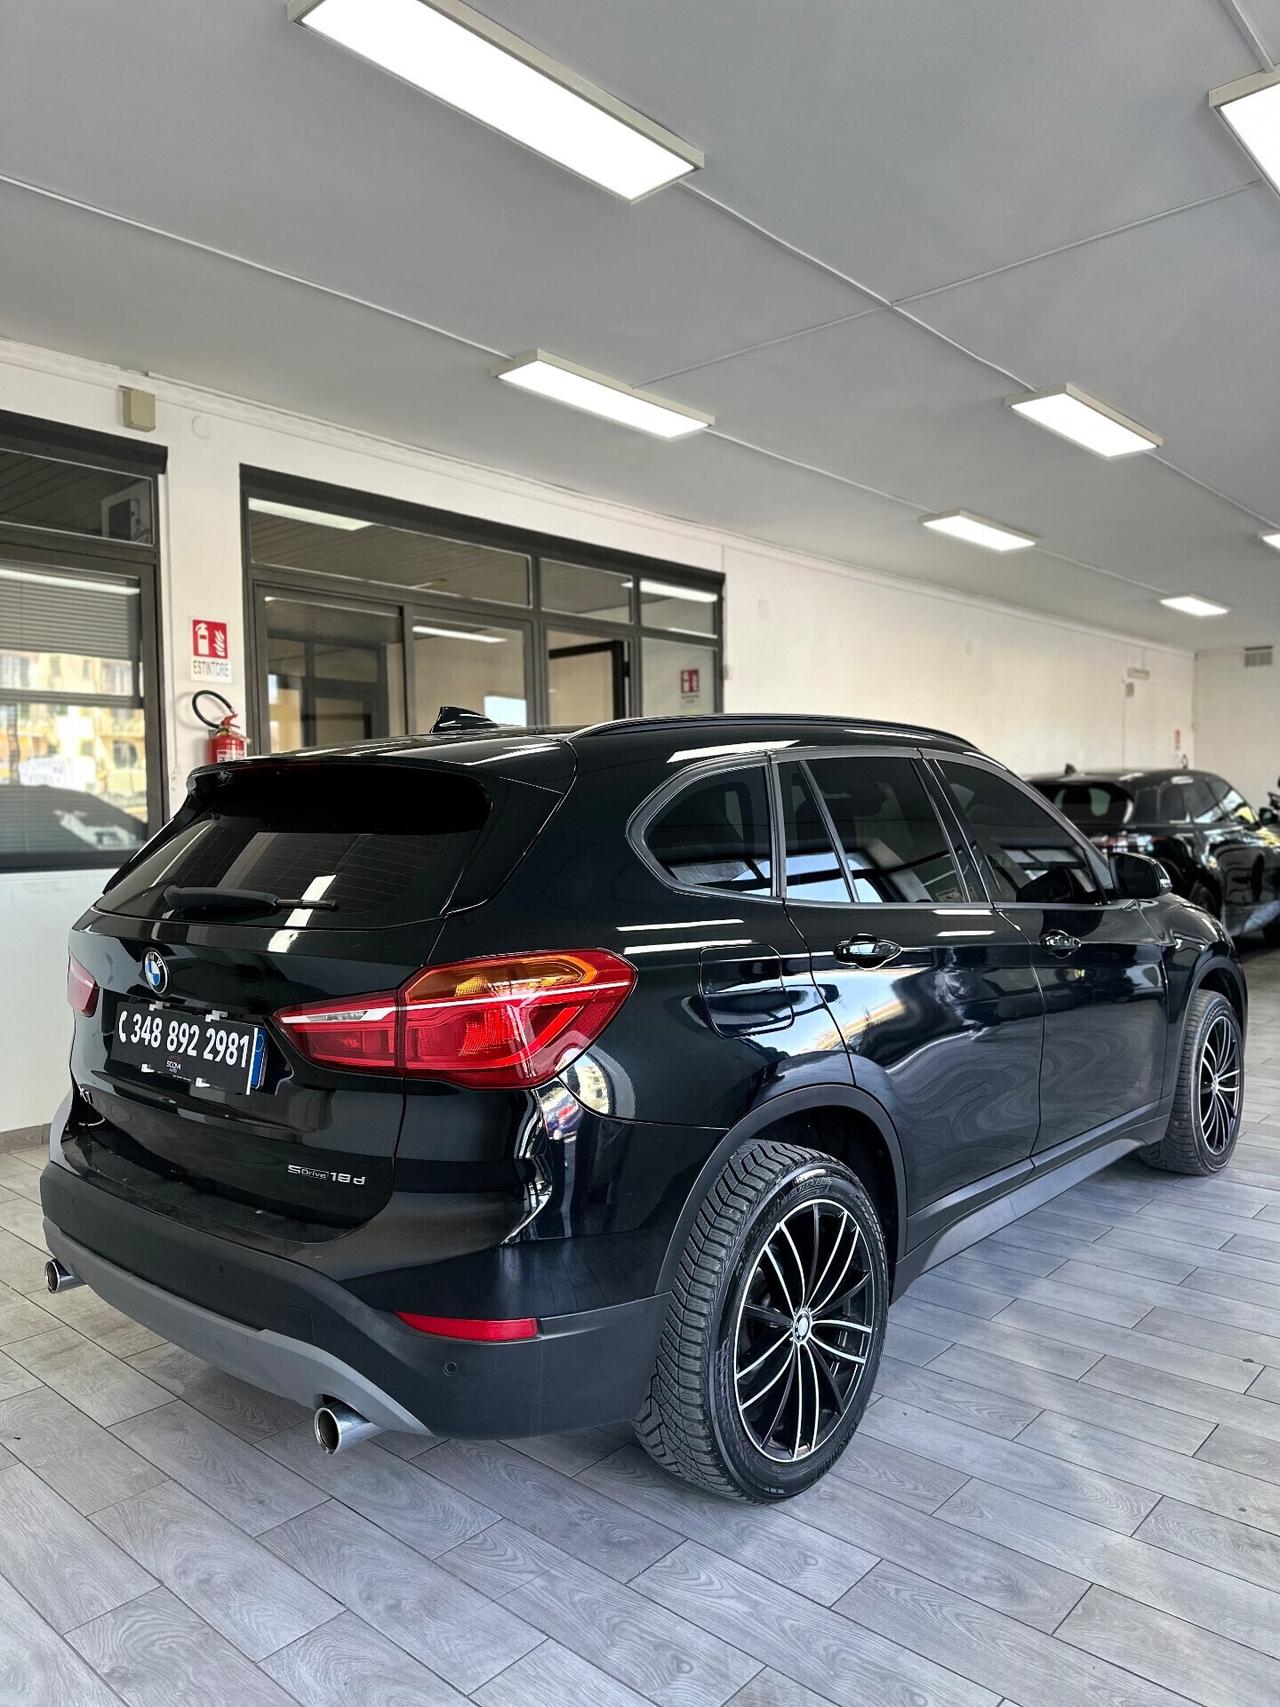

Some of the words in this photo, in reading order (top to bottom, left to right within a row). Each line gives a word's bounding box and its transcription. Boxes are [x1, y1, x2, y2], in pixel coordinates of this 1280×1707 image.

[193, 660, 229, 677] ESTINTORE
[130, 1013, 163, 1048] 348
[166, 1020, 200, 1057] 892
[203, 1027, 250, 1068] 2981
